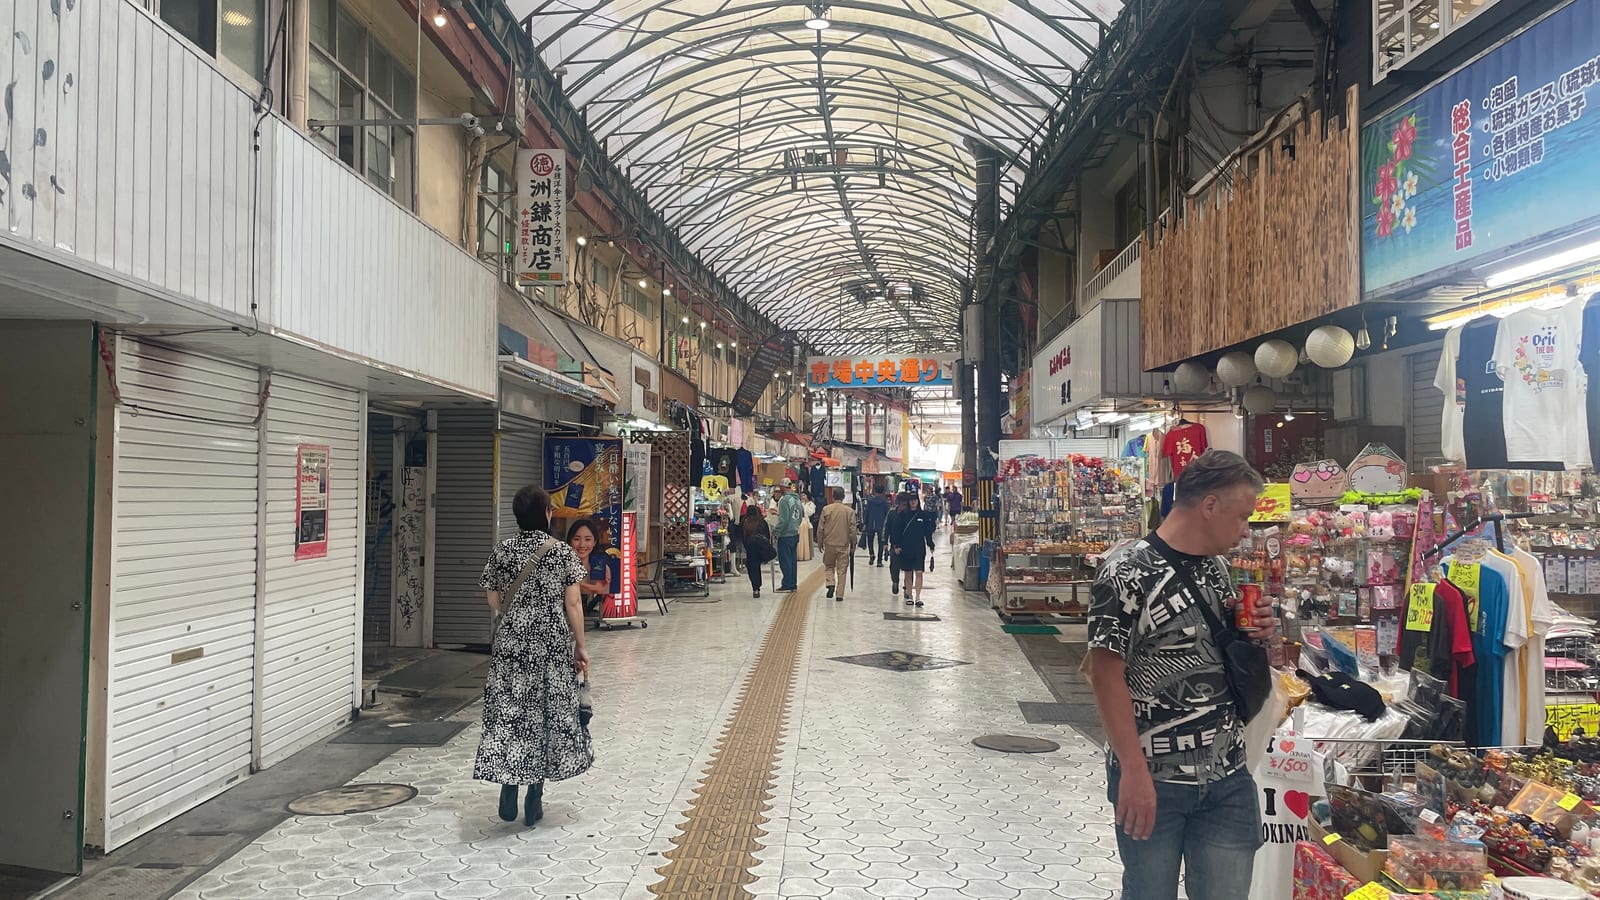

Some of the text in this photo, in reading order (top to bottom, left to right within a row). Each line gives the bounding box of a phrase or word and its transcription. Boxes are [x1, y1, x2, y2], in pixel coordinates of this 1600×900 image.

[1453, 100, 1472, 249] 総合土産品
[528, 178, 552, 271] 洲鎌商店
[811, 359, 938, 384] 市場中央通り
